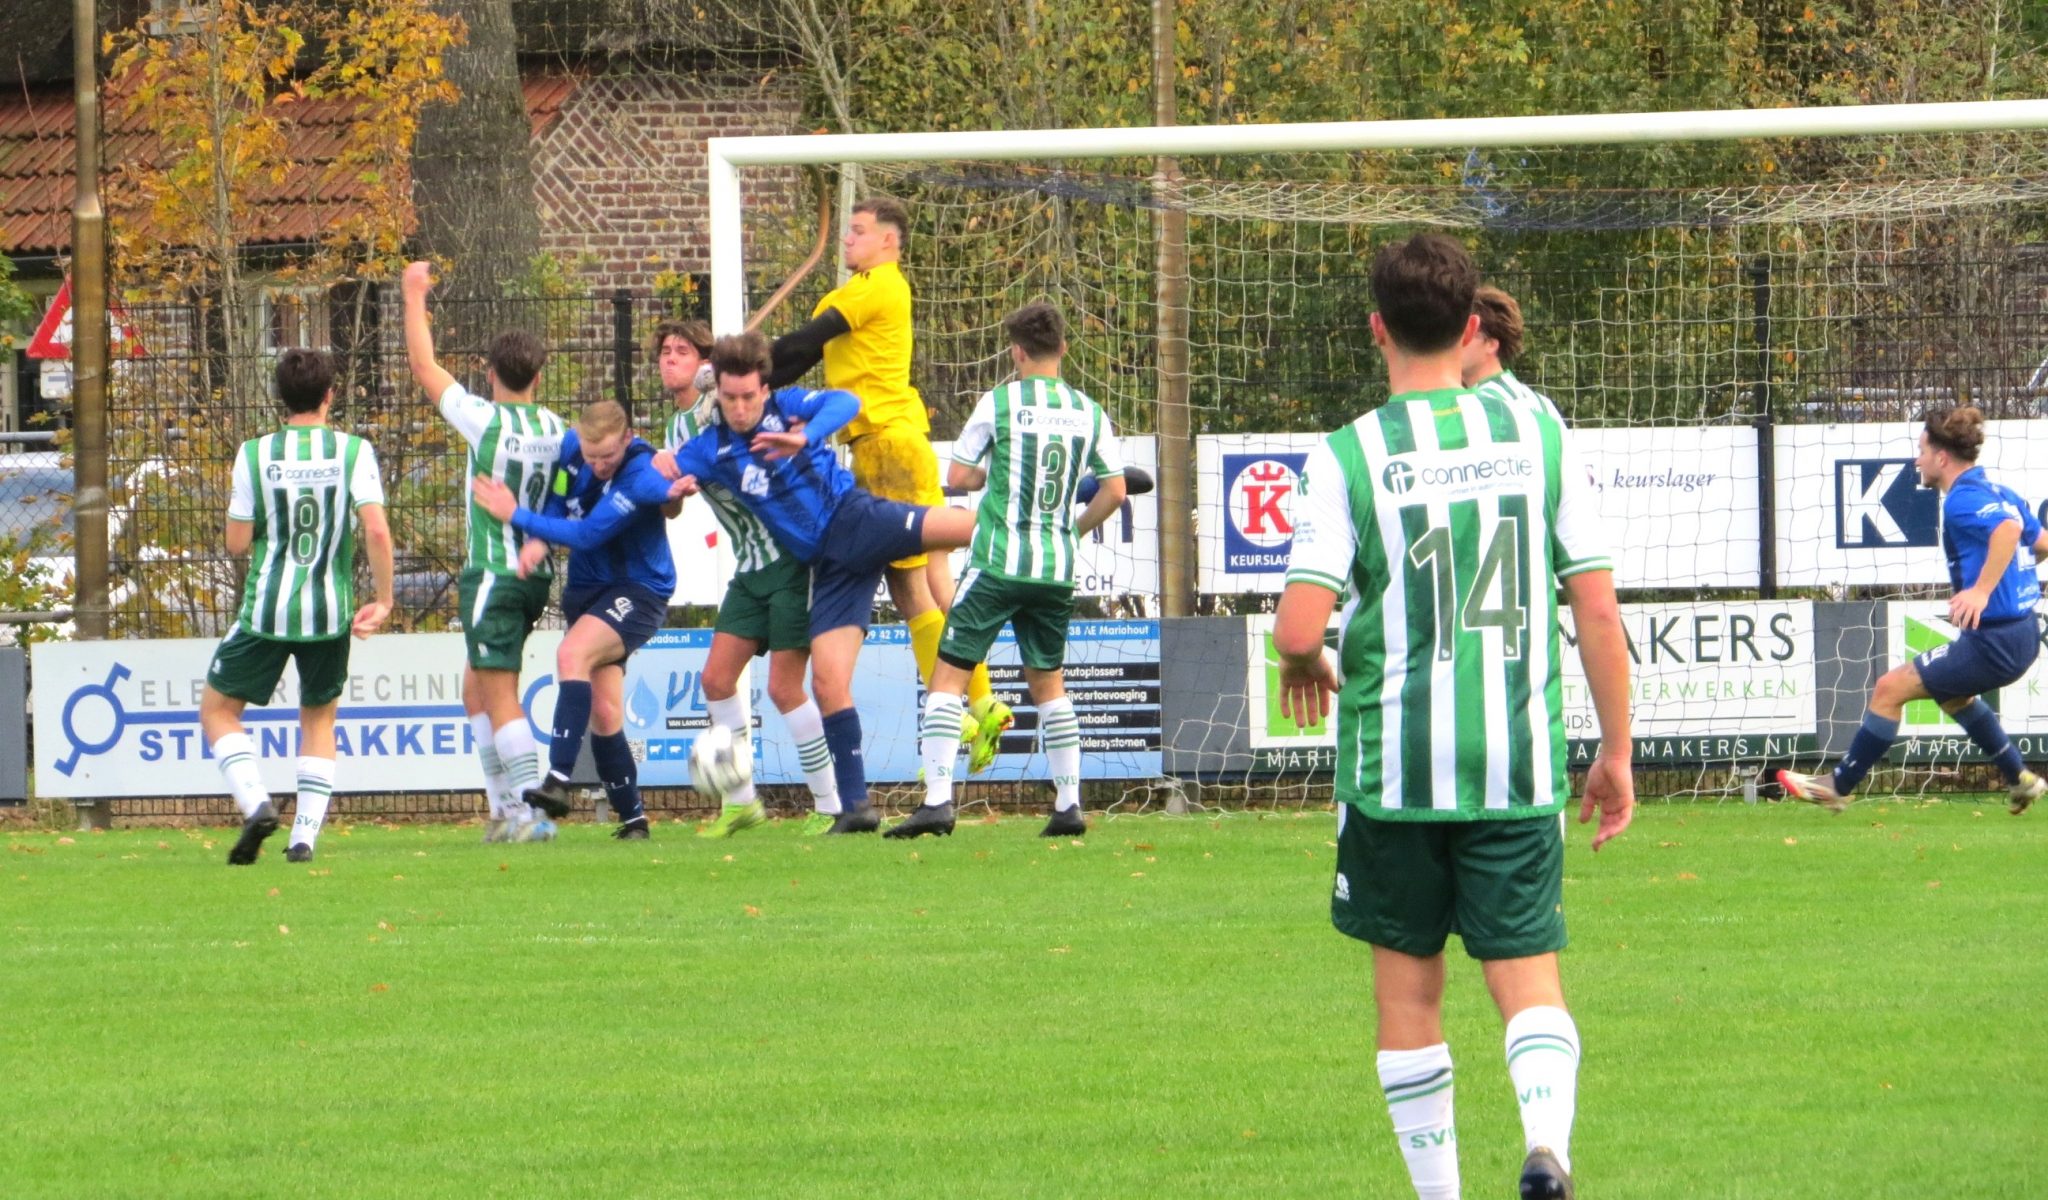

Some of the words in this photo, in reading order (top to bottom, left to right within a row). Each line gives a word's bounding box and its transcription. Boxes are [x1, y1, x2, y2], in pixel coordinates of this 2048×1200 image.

[1038, 441, 1067, 514] 3
[1422, 456, 1532, 485] connectie
[1613, 467, 1716, 492] keurslager
[1242, 485, 1294, 534] K
[1842, 463, 1909, 544] K
[292, 494, 320, 567] 8
[1230, 554, 1291, 566] KEURSLAG
[1409, 517, 1528, 662] 14
[646, 633, 690, 645] quados.nl
[988, 669, 1020, 678] ratuur
[993, 690, 1022, 704] deling
[1563, 679, 1796, 702] TIERWERKEN
[1079, 714, 1119, 724] mbaden
[1267, 750, 1331, 768] MARI
[1520, 1086, 1552, 1105] VH
